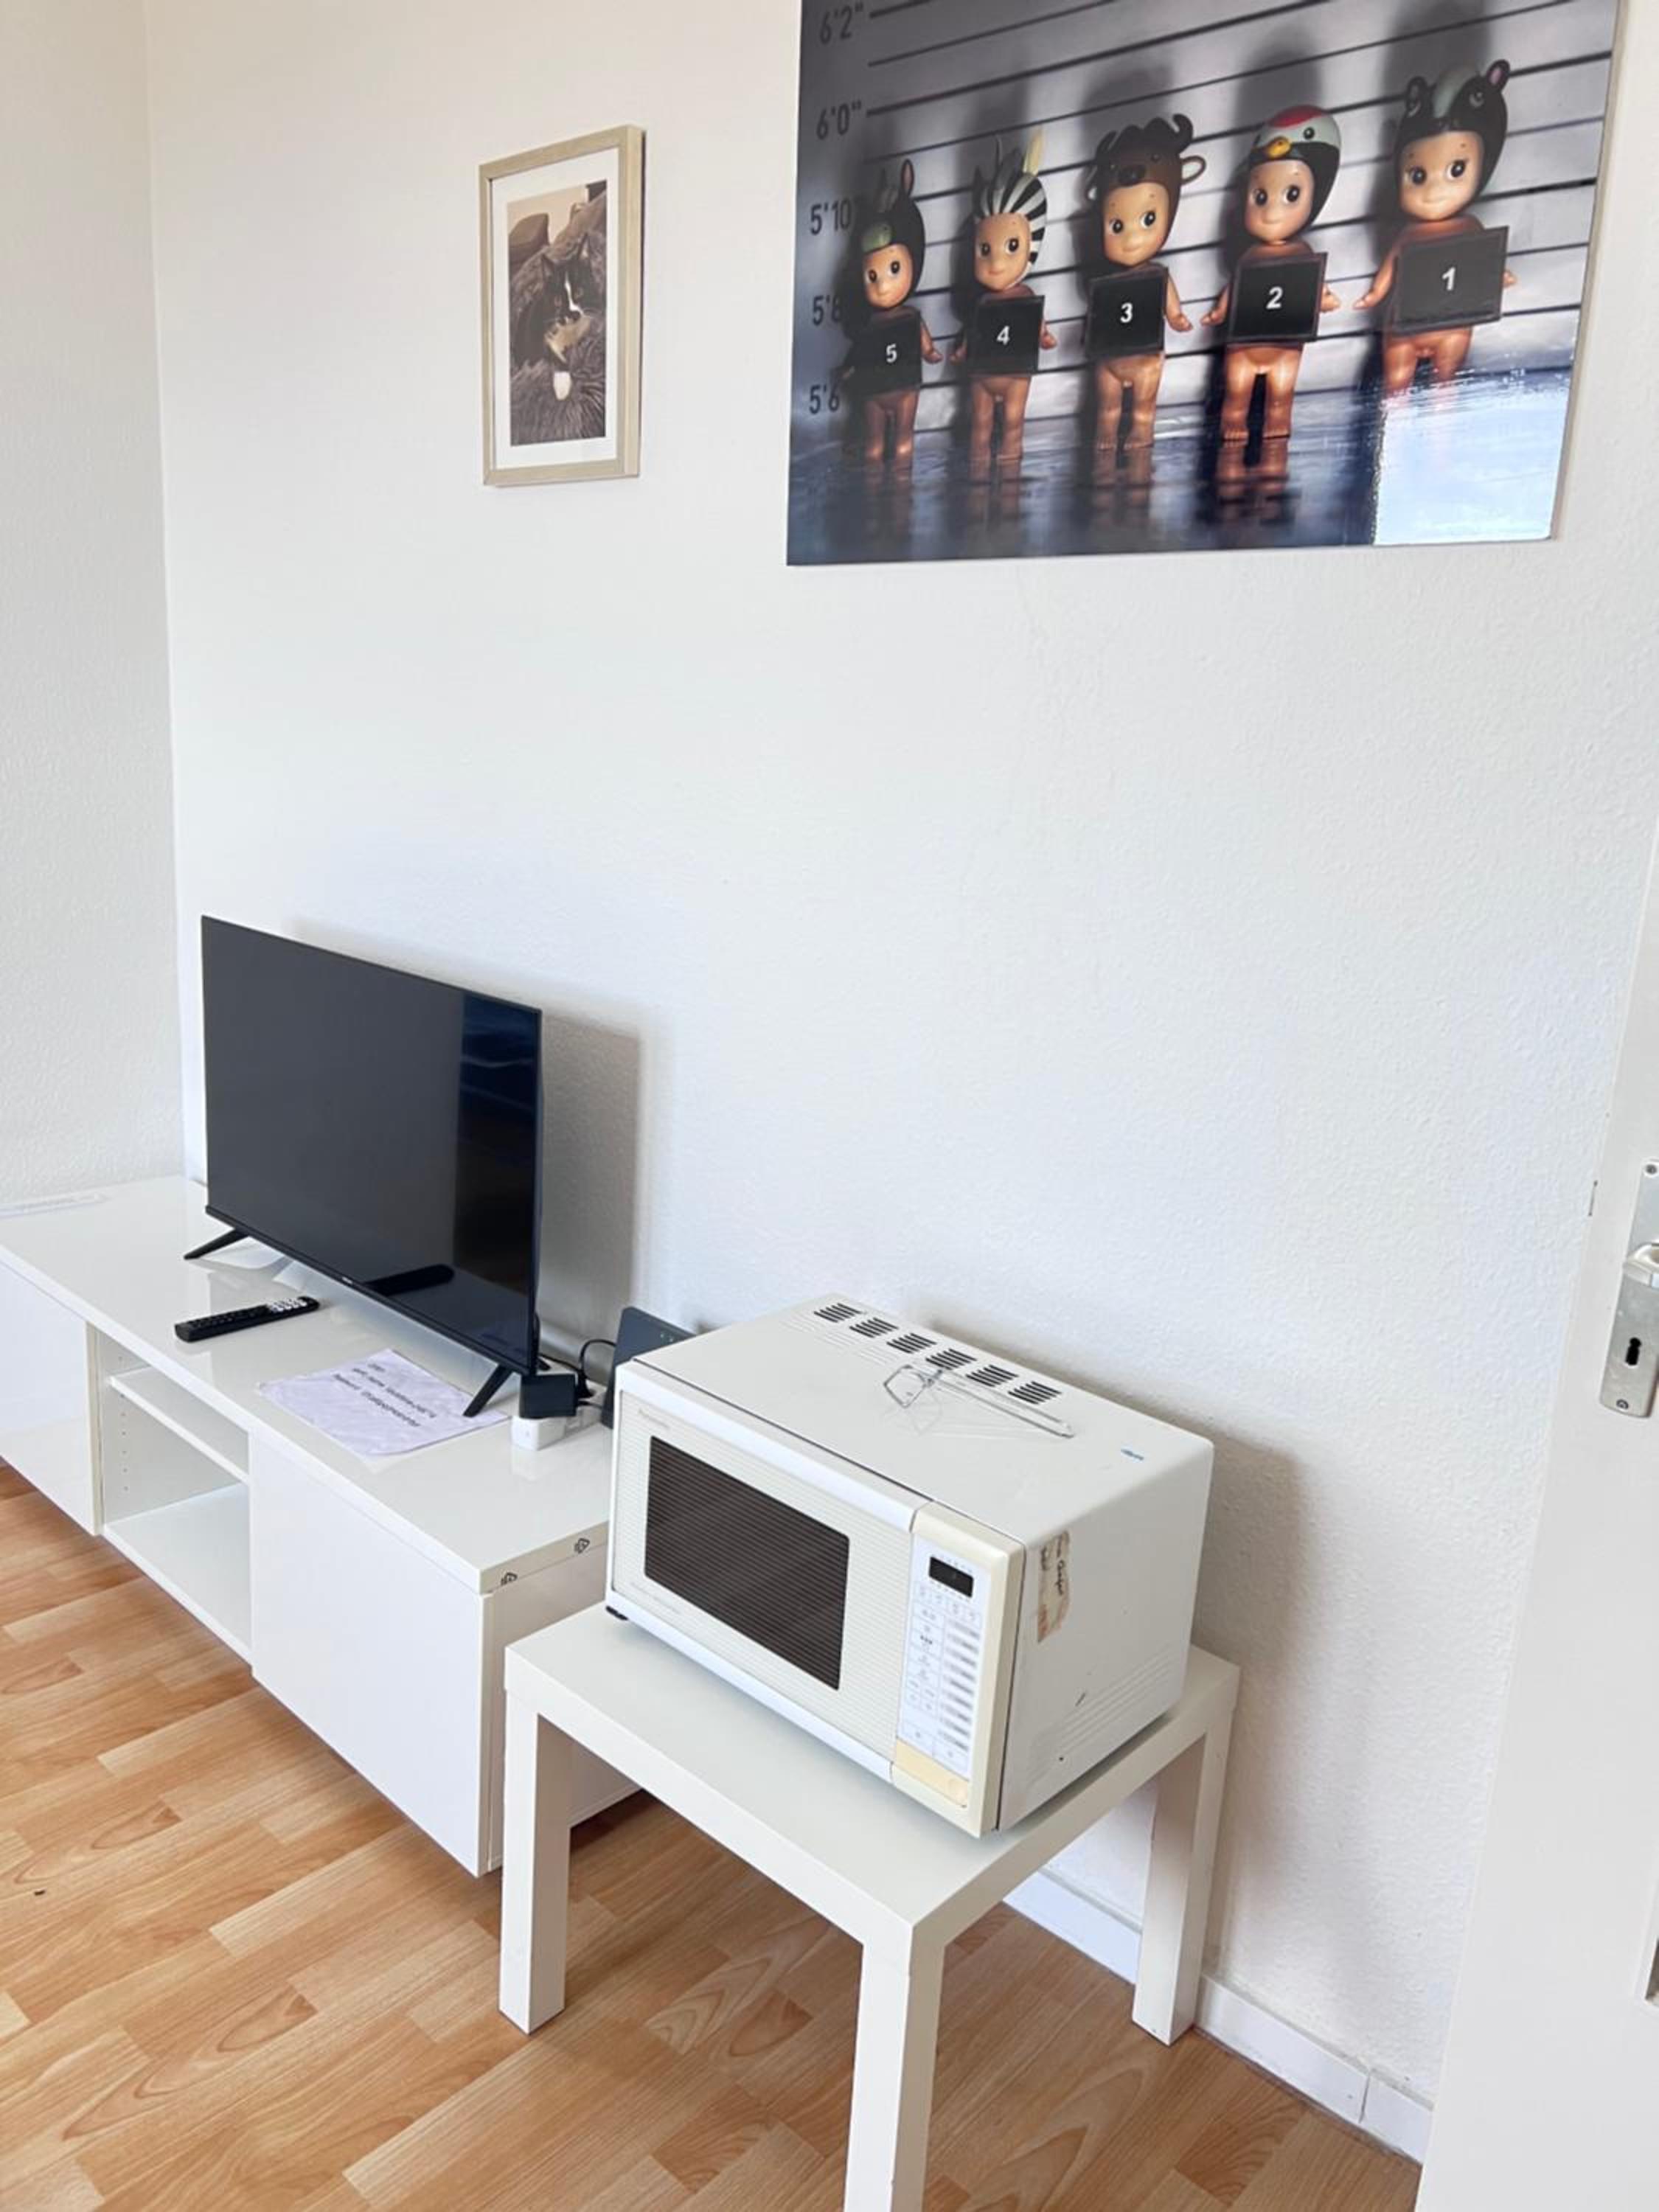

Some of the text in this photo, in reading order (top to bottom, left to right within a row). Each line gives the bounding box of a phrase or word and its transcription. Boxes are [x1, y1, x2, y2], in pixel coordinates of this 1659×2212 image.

[820, 3, 863, 44] 6'2"
[816, 100, 861, 140] 6'0"
[1442, 267, 1456, 291] 1
[1266, 286, 1283, 310] 2
[1120, 302, 1133, 324] 3
[997, 325, 1010, 345] 4
[886, 343, 898, 364] 5
